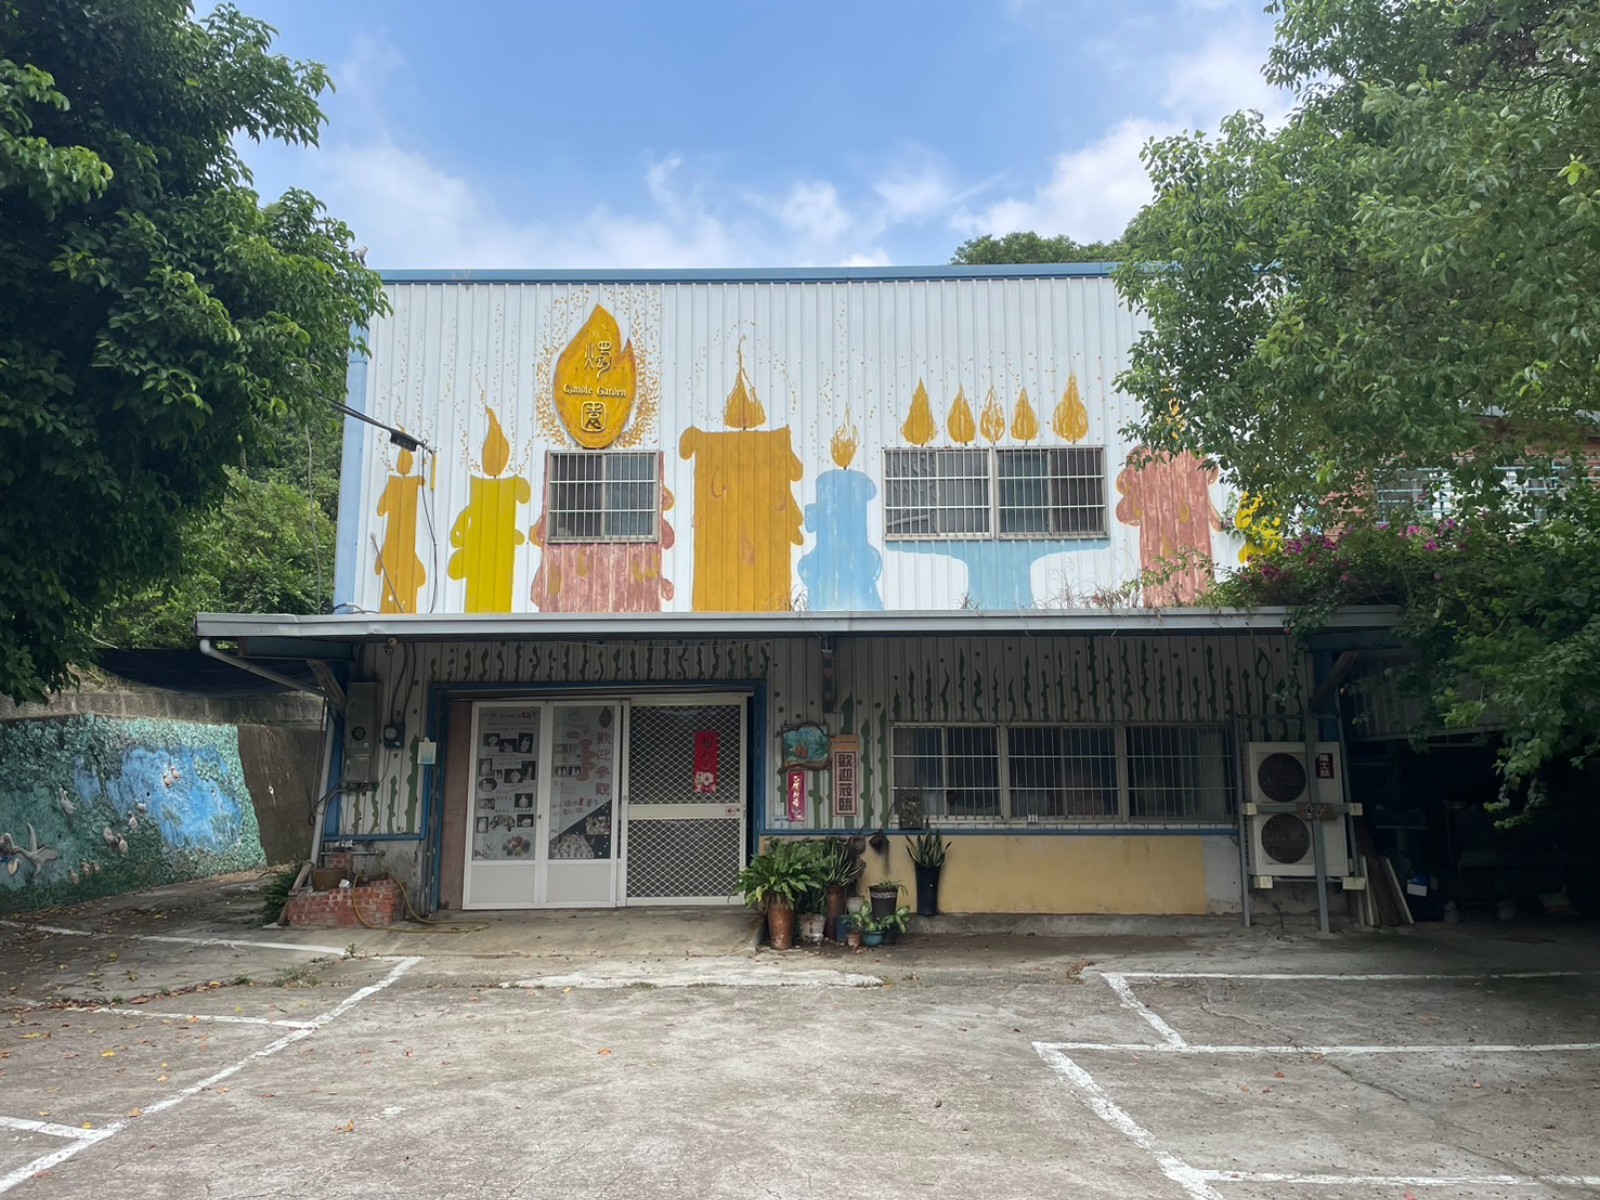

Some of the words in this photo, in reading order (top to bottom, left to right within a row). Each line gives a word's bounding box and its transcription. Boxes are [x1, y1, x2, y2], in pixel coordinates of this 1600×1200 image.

[563, 384, 592, 396] Candle
[597, 386, 627, 398] Garden
[838, 753, 853, 811] 歡迎蒞臨
